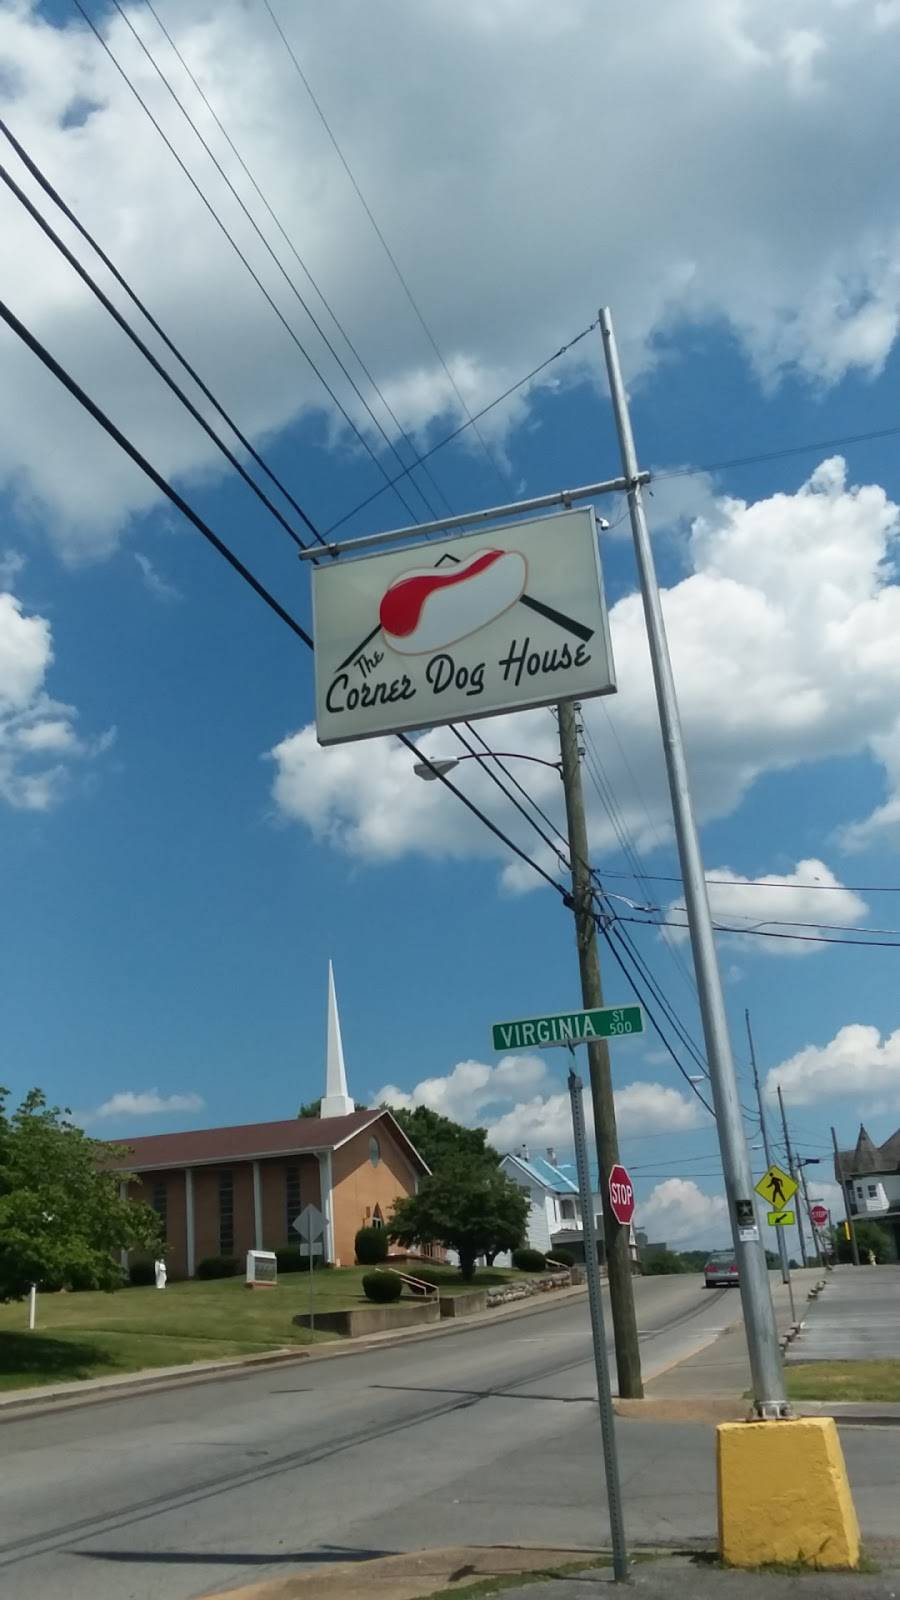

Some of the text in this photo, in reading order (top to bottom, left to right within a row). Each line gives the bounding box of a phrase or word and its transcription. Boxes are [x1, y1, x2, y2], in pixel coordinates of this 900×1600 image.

[326, 637, 592, 713] Corner Dog House
[354, 651, 384, 678] The
[501, 1010, 625, 1048] VIRGINIA ST
[609, 1021, 632, 1035] 500
[611, 1182, 632, 1205] STOP
